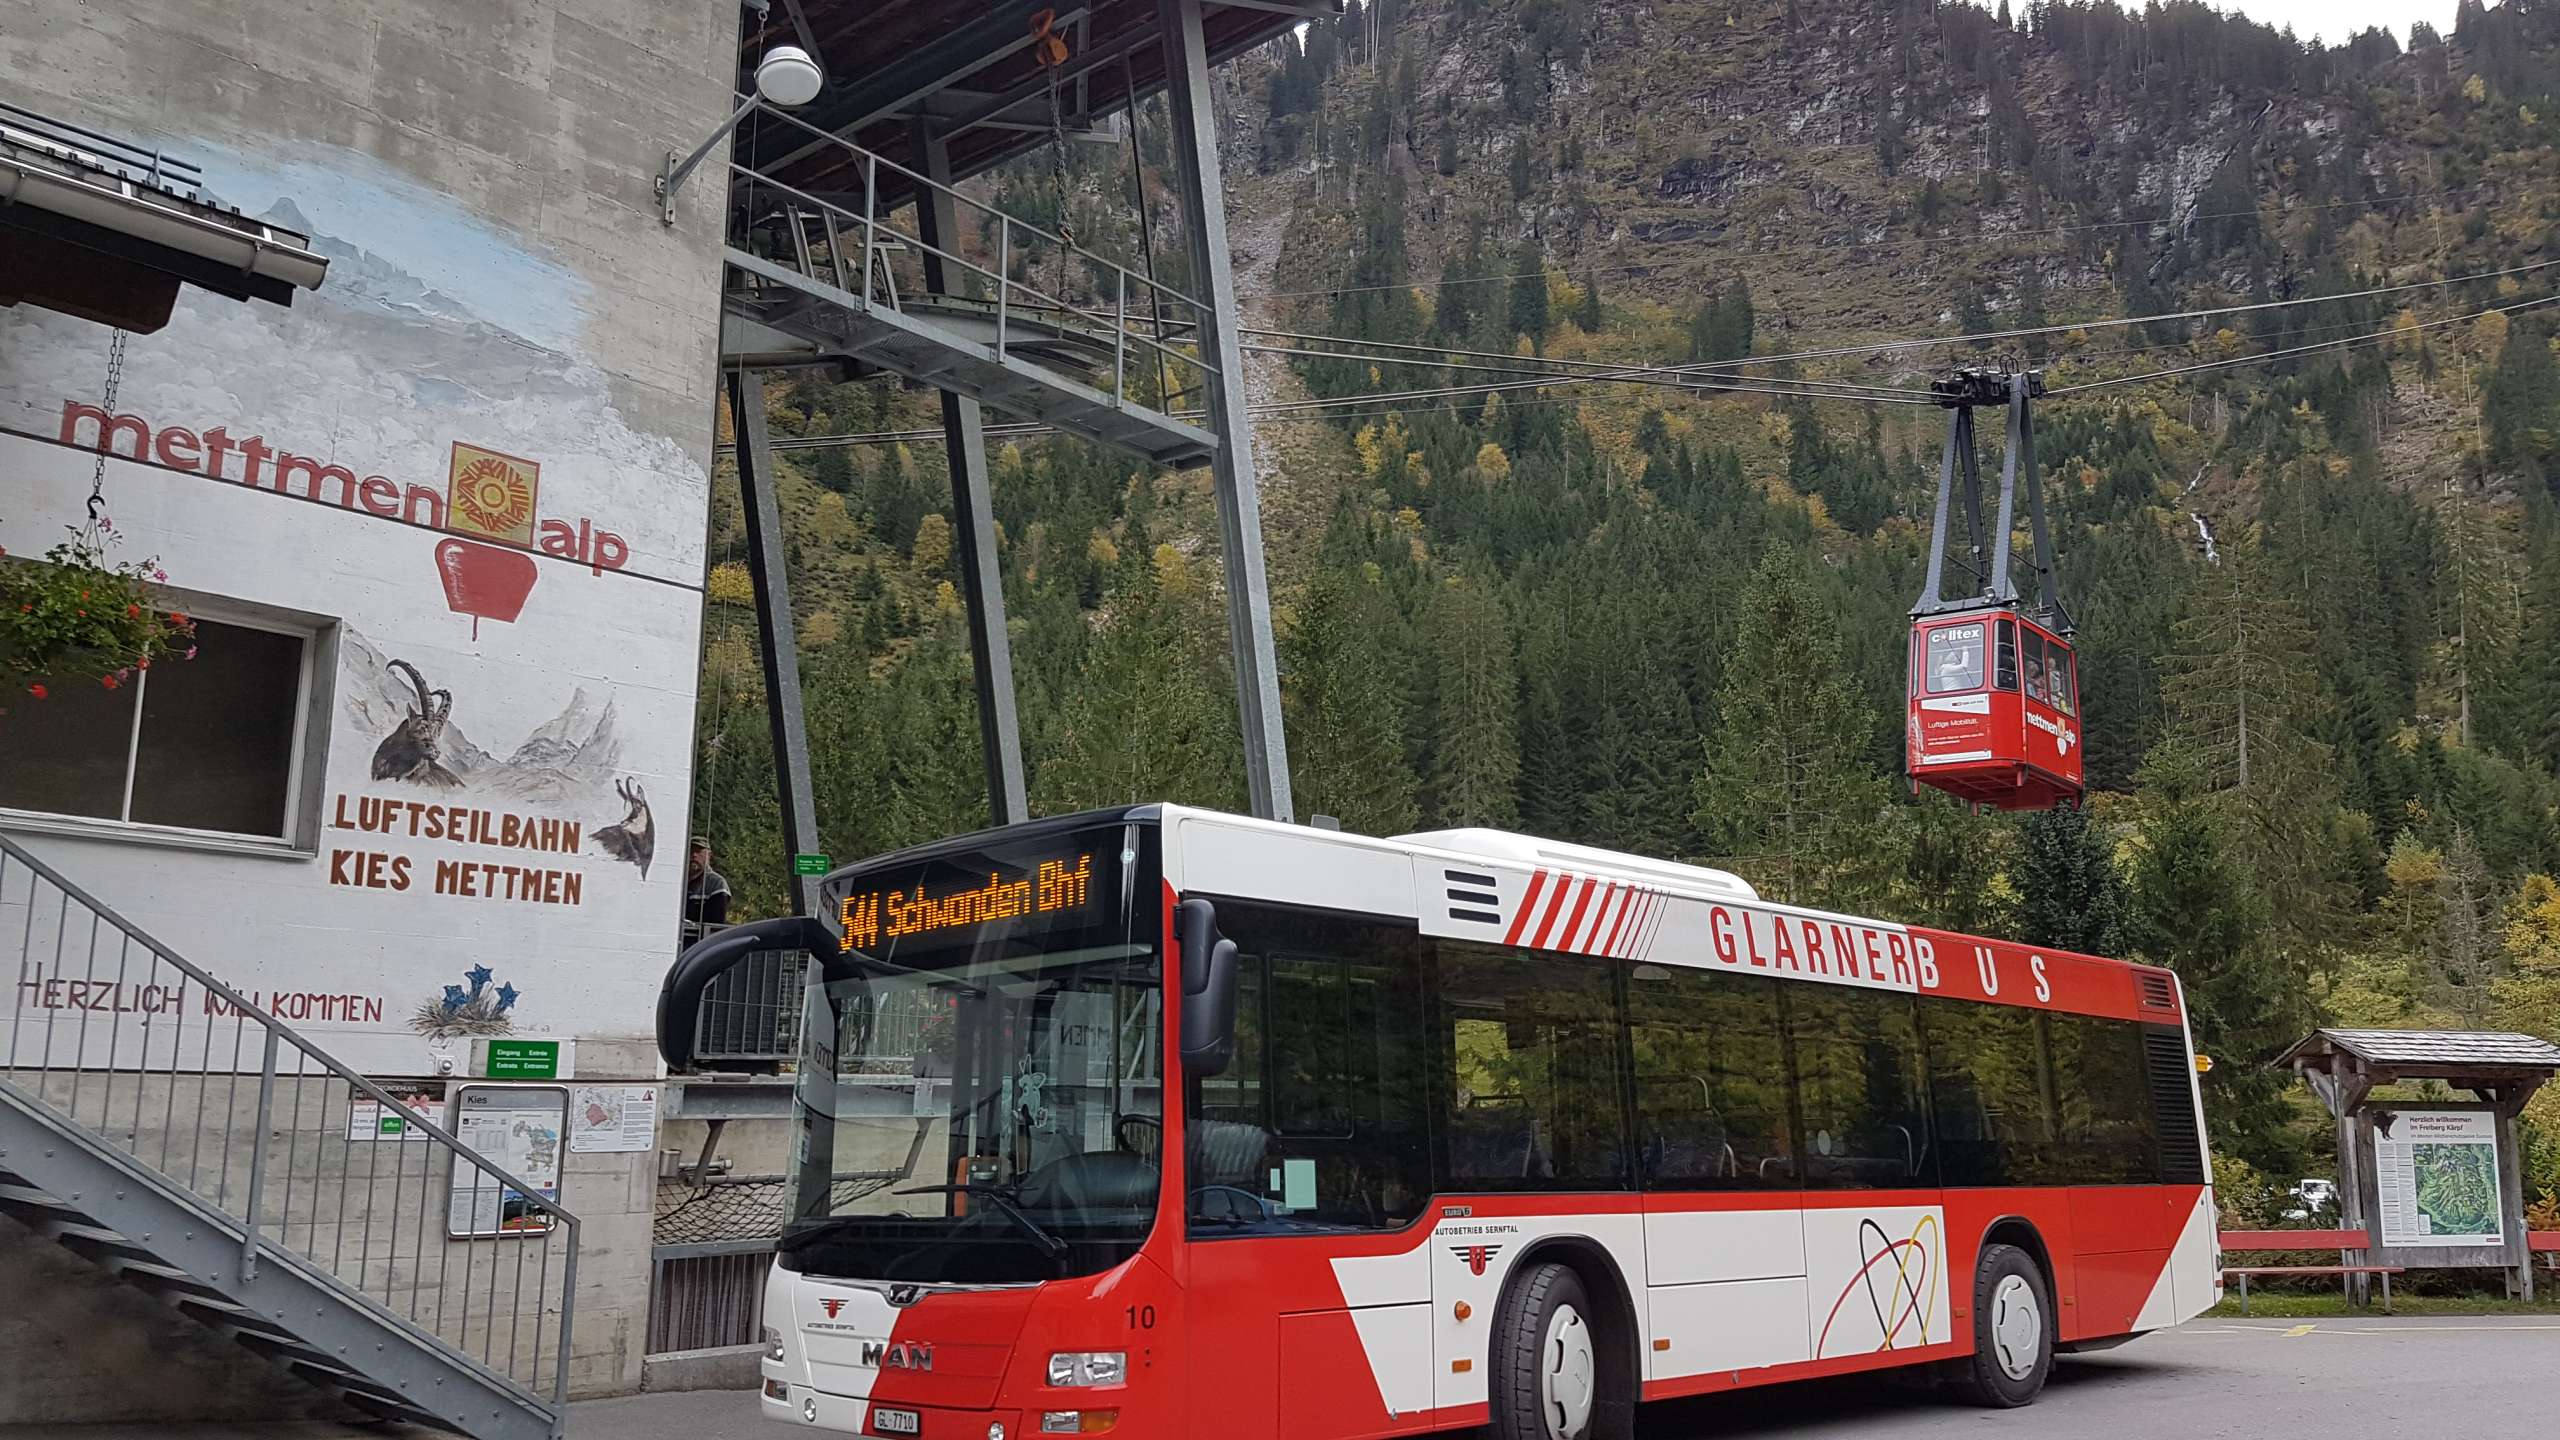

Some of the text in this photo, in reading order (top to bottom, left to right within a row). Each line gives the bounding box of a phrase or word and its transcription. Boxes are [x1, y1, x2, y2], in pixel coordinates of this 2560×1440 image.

[59, 400, 628, 578] mettmen alp
[335, 793, 581, 854] LUFTSEILBAHN
[330, 849, 582, 905] KIES METTMEN
[839, 892, 879, 953] 544
[886, 872, 1031, 937] Schwanden
[1038, 855, 1091, 912] Bhf
[18, 961, 183, 1015] HERZLICH
[496, 1048, 521, 1057] Eingang
[467, 1095, 488, 1105] Kies
[1435, 1225, 1519, 1236] AUTOBETRIEB SERNFTAL
[1125, 1304, 1156, 1330] 10
[861, 1342, 933, 1372] MAN
